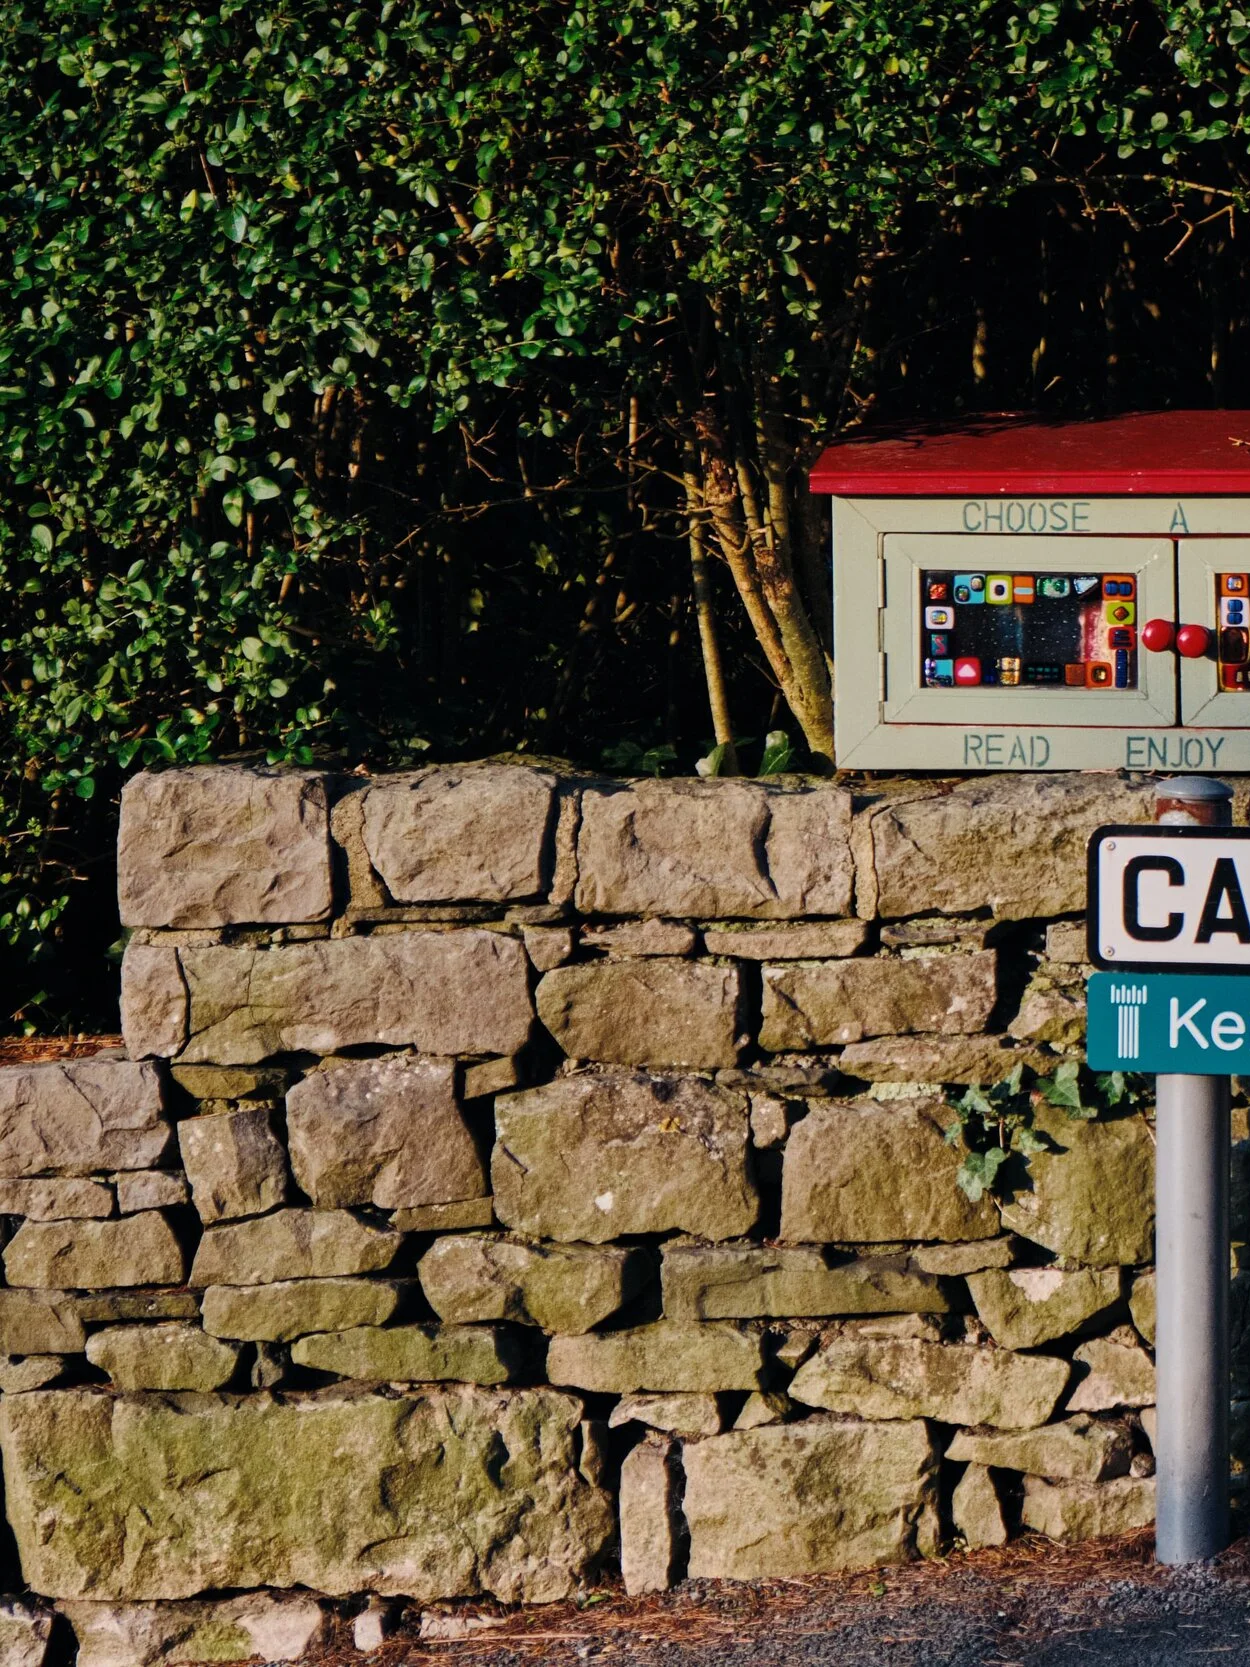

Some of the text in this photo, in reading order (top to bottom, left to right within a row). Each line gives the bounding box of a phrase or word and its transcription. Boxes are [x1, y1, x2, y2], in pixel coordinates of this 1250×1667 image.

[962, 501, 1091, 533] CHOOSE
[1169, 502, 1190, 533] A
[962, 734, 1050, 768] READ
[1126, 736, 1226, 769] ENJOY
